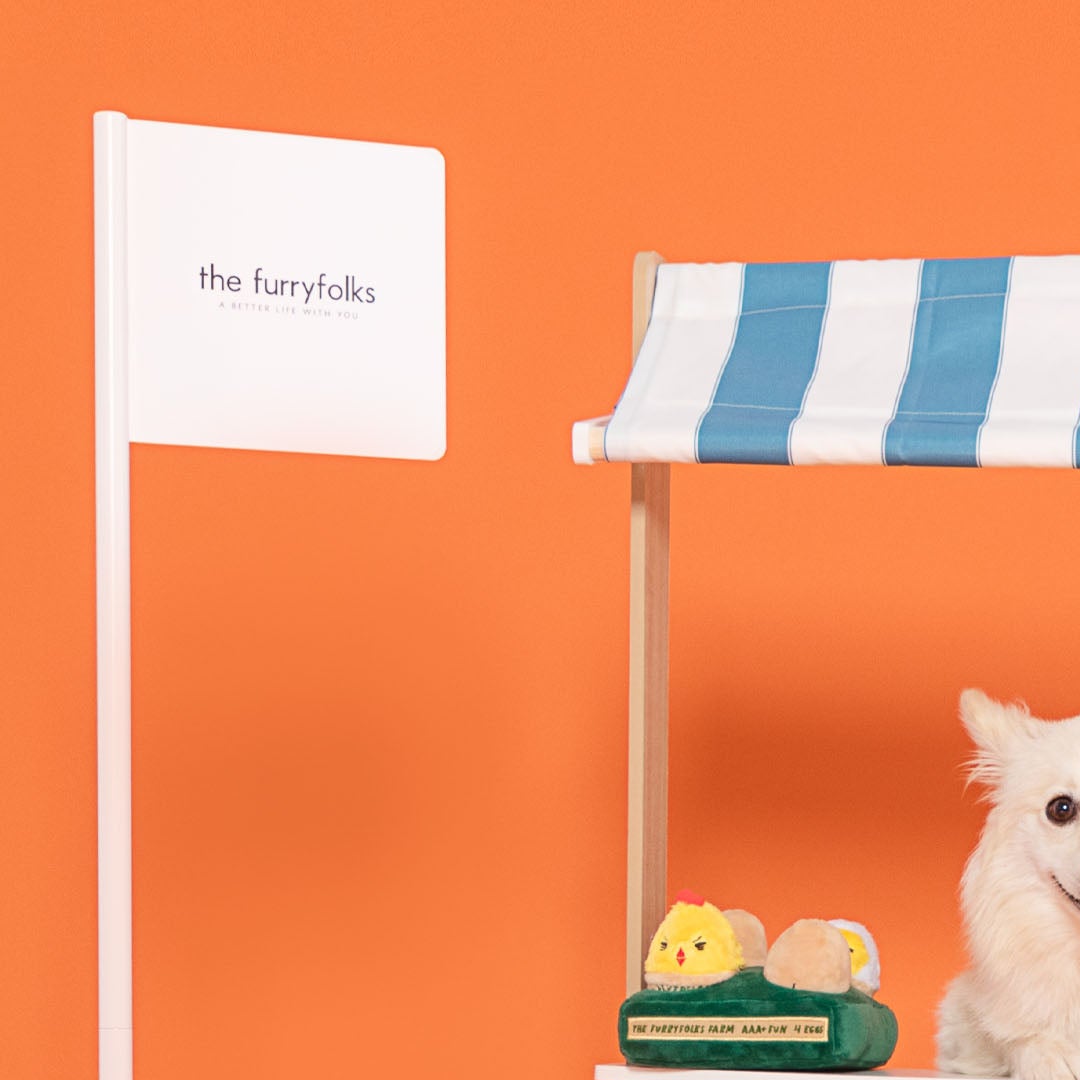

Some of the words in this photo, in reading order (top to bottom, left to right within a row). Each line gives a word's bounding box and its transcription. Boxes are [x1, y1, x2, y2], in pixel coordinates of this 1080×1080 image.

[200, 263, 241, 292] the
[253, 267, 376, 304] furryfolks
[219, 301, 225, 309] A
[231, 302, 270, 313] BETTER
[275, 306, 296, 315] LIFE
[303, 308, 331, 318] WITH
[338, 311, 359, 320] YOU
[632, 1024, 647, 1033] THE
[650, 1024, 705, 1034] FURRYFOLKS
[708, 1024, 735, 1034] FARM
[793, 1024, 801, 1034] 4
[803, 1024, 824, 1034] EGGS
